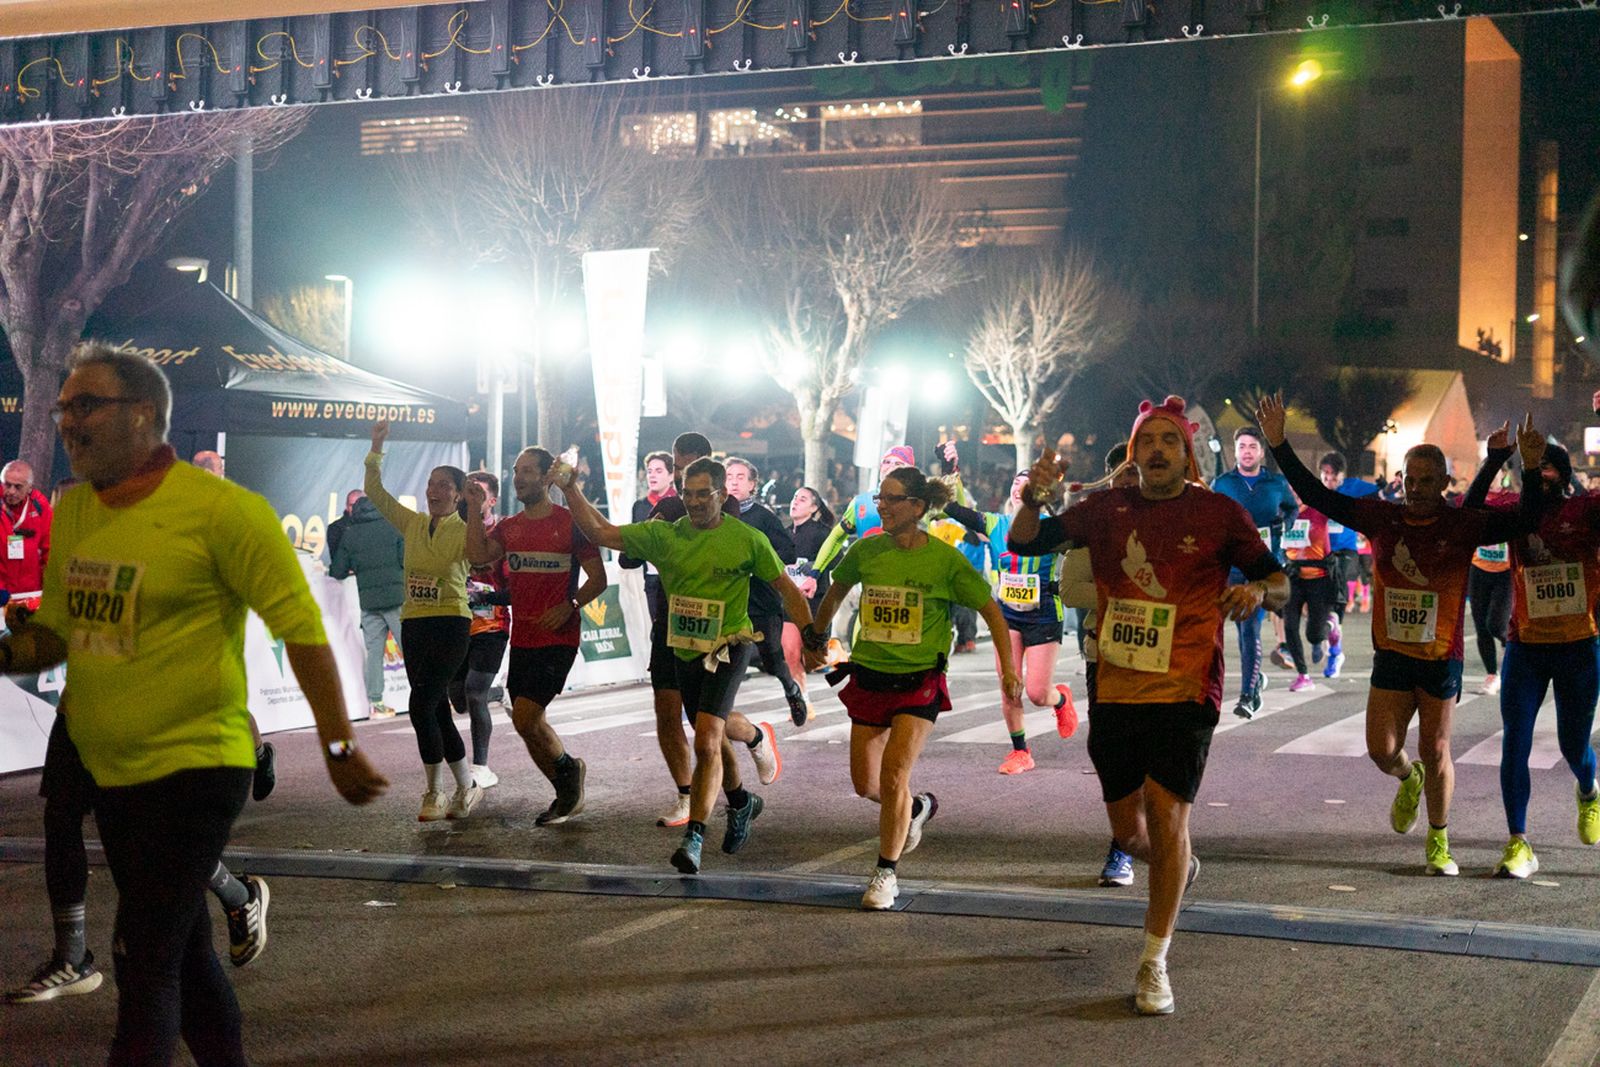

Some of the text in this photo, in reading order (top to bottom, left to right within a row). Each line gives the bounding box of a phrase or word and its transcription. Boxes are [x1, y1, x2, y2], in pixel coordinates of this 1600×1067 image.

[271, 401, 436, 424] www.evedeport.es
[522, 557, 560, 569] Avanza
[1135, 567, 1153, 587] 43
[410, 585, 439, 600] 3333
[1006, 587, 1034, 600] 13521
[1536, 582, 1576, 600] 5080
[67, 589, 124, 625] 13820
[873, 606, 911, 625] 9518
[1391, 607, 1428, 625] 6982
[678, 616, 711, 635] 9517
[1113, 623, 1159, 649] 6059
